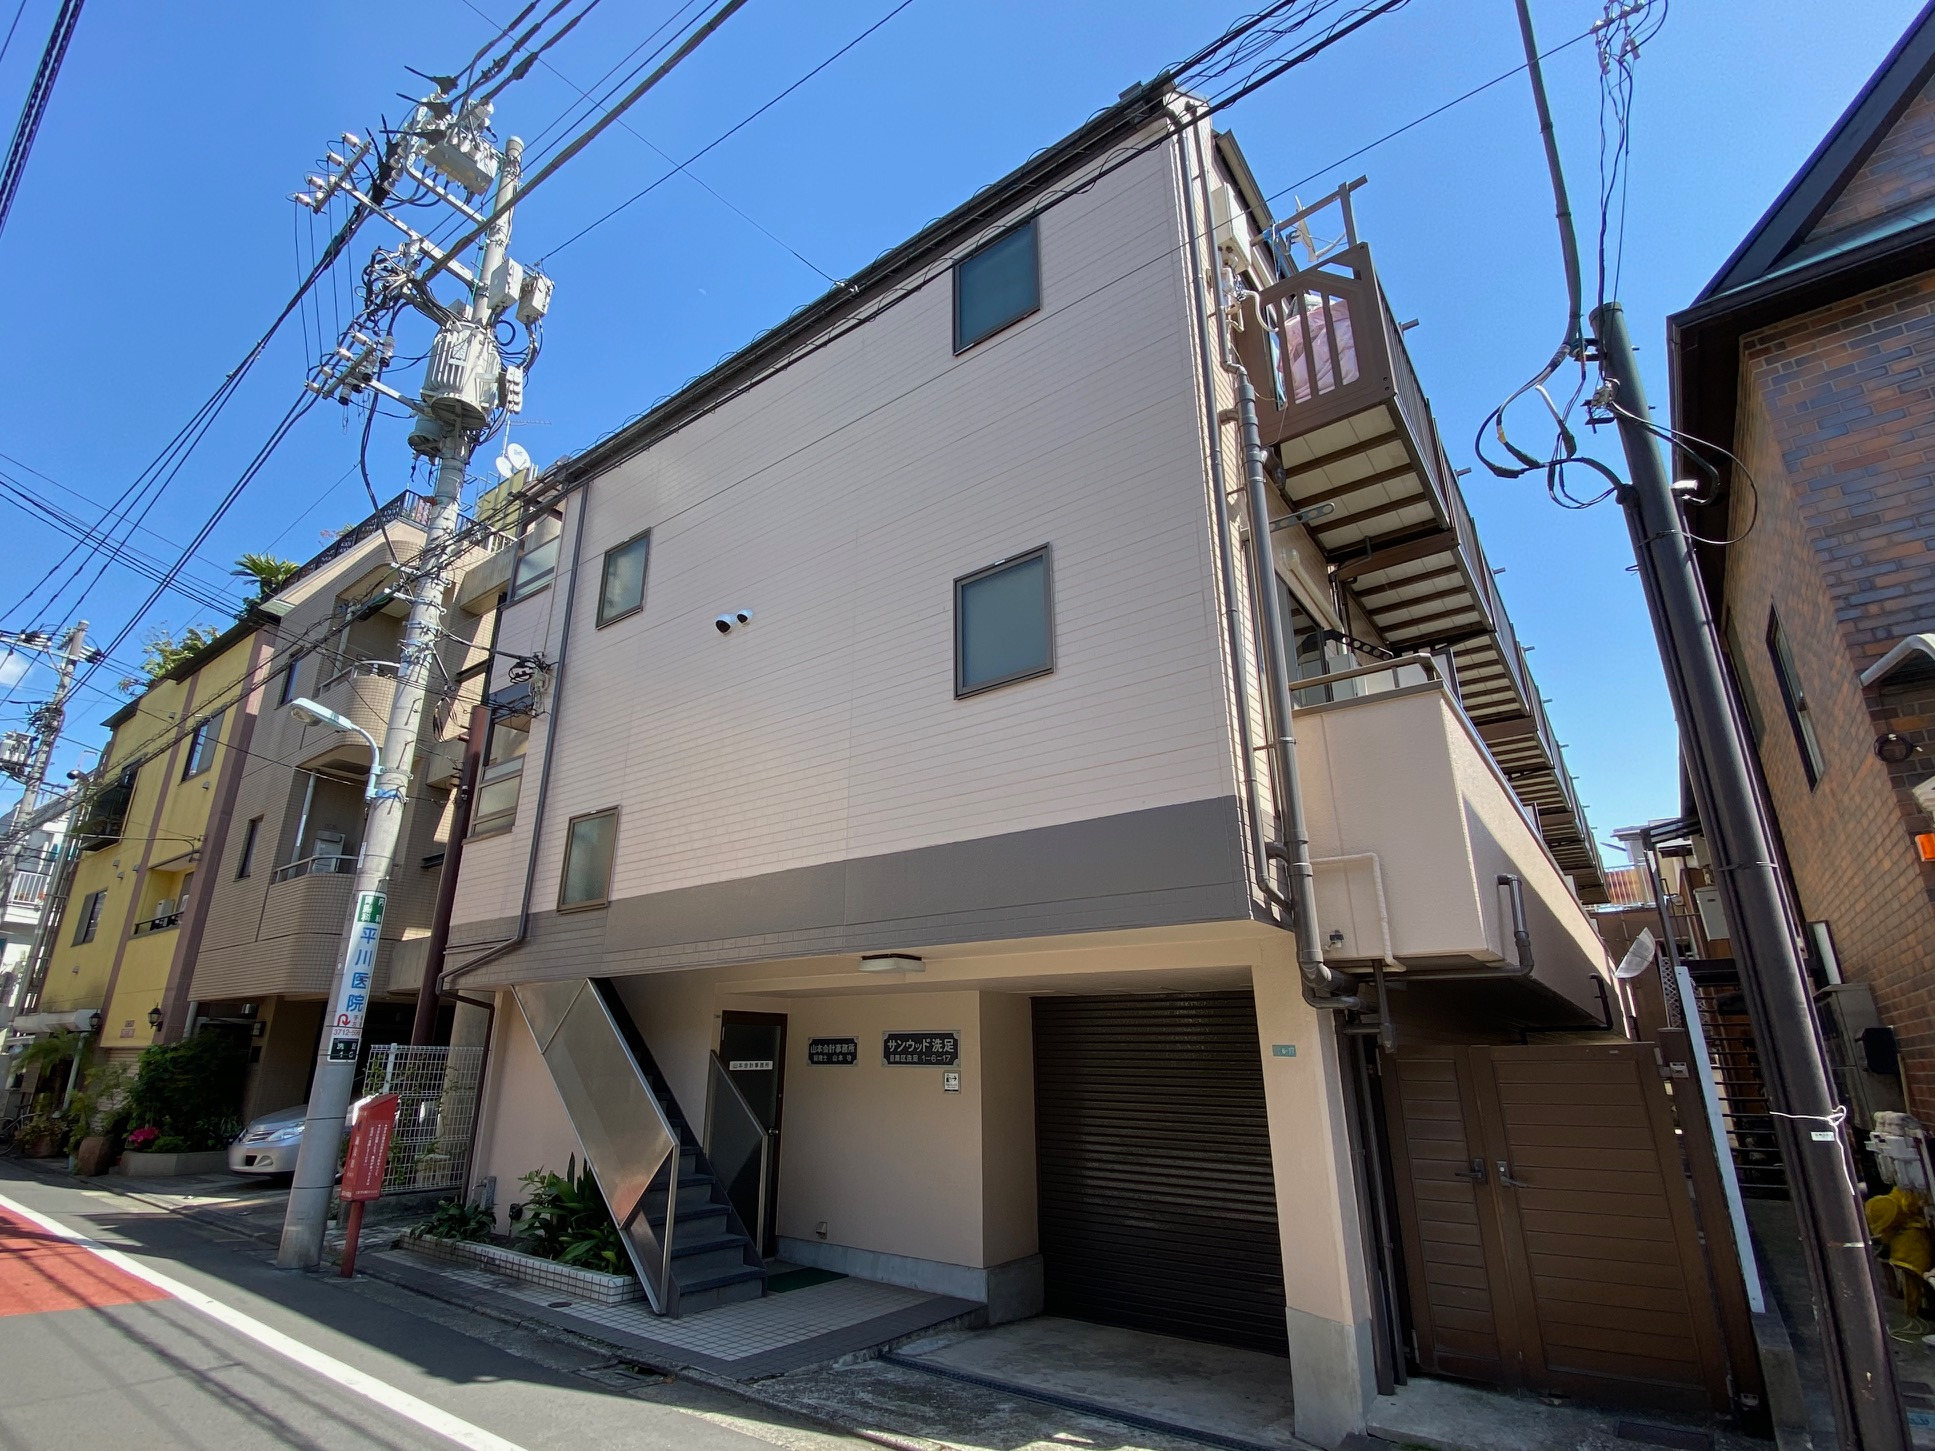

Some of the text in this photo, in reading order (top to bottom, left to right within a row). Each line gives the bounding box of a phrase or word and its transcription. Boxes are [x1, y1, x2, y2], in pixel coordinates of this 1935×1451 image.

[346, 926, 378, 1012] 平川医院
[810, 1043, 855, 1053] 山本会計事務所
[921, 1054, 951, 1063] 1-6-17
